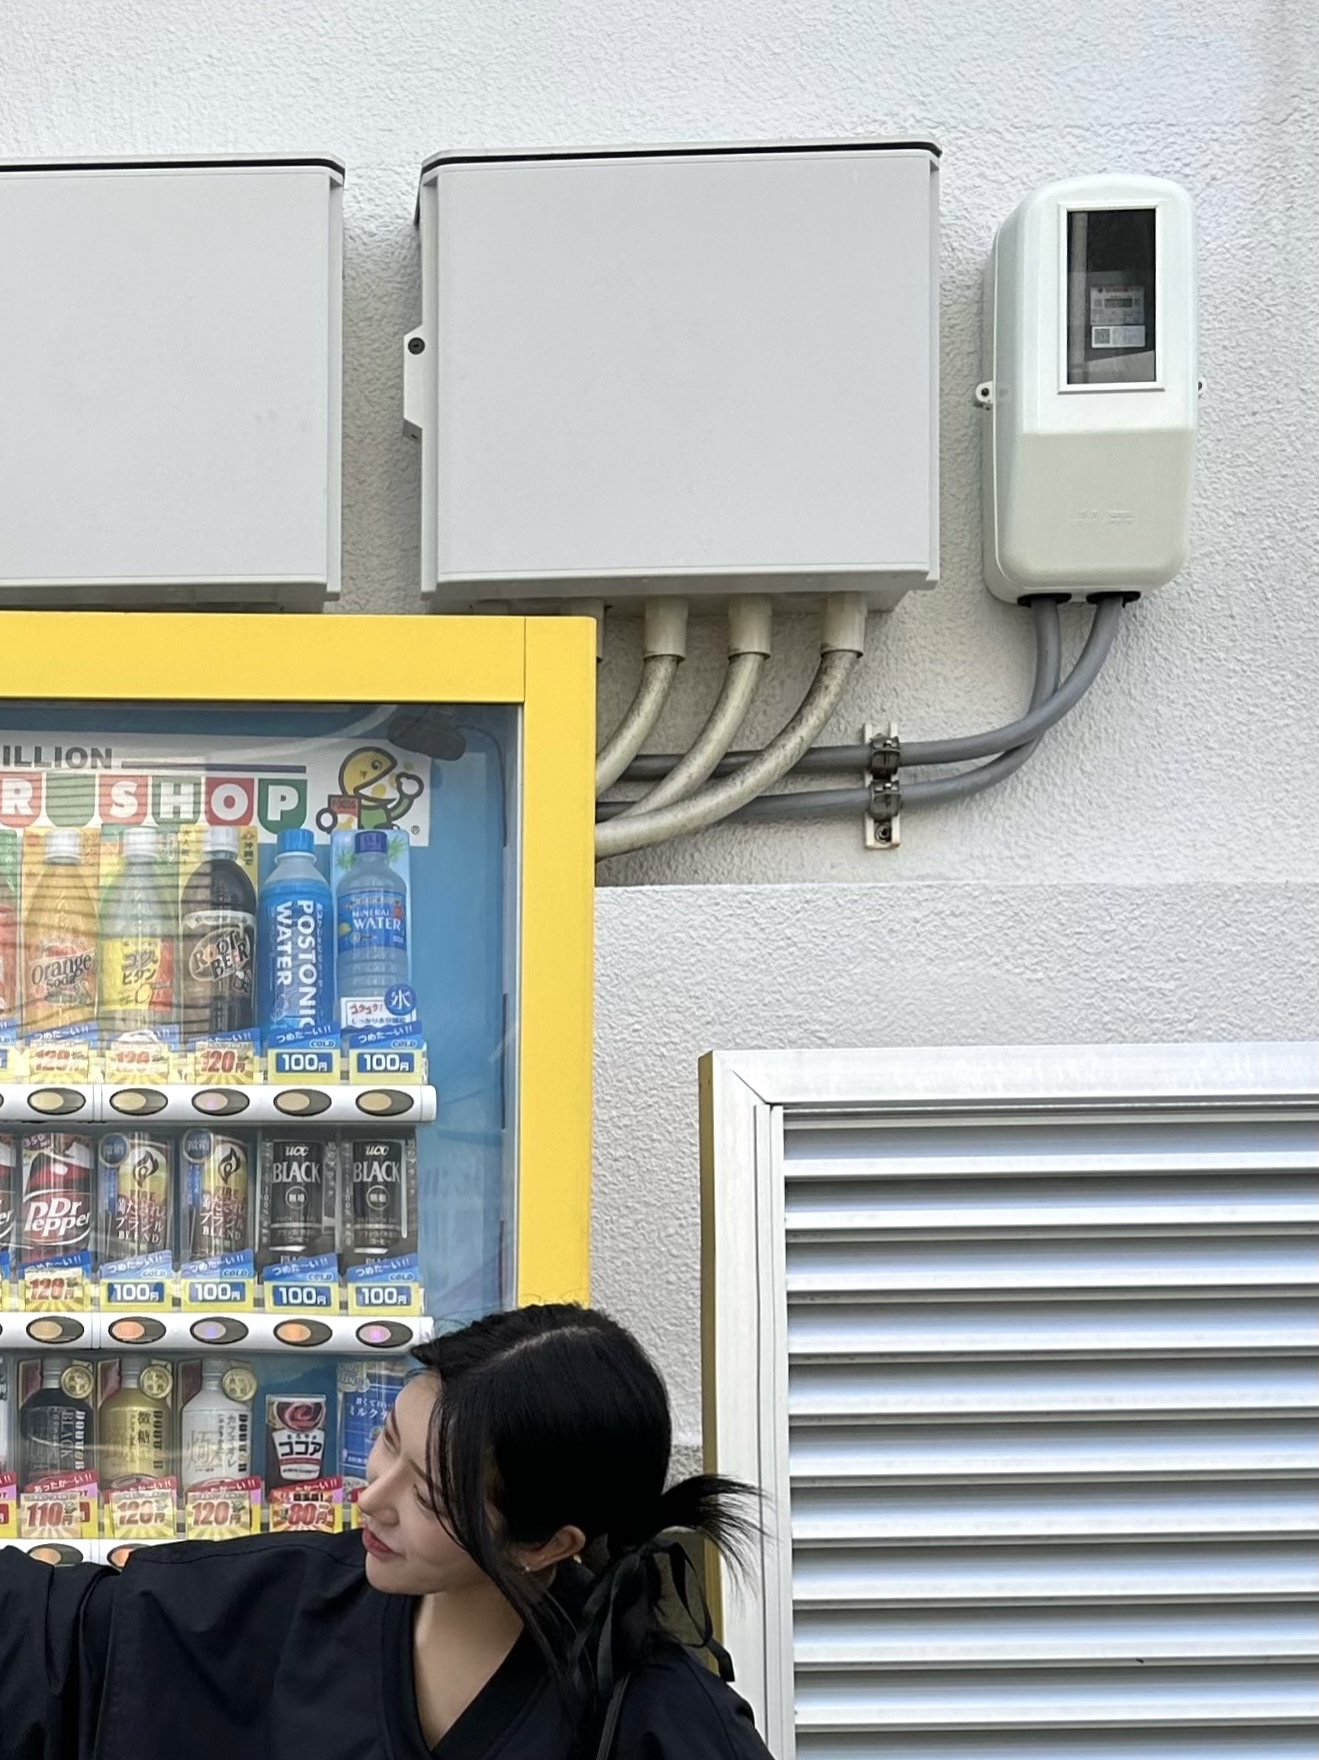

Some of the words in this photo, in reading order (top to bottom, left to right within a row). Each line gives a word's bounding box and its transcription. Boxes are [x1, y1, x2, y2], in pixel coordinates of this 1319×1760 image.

[108, 780, 300, 822] SHOP
[353, 917, 403, 931] WATER
[276, 901, 293, 986] WATER
[30, 953, 93, 987] Orange
[211, 941, 251, 979] BEER
[46, 973, 77, 989] soda
[282, 1053, 328, 1073] 100円
[364, 1053, 409, 1073] 100円
[272, 1161, 321, 1183] BLACK
[353, 1161, 400, 1183] BLACK
[48, 1197, 82, 1218] Dr
[24, 1201, 91, 1238] Pepper
[113, 1283, 160, 1302] 100円
[195, 1283, 241, 1301] 100円
[279, 1287, 326, 1305] 100円
[361, 1287, 408, 1305] 100円
[278, 1440, 322, 1457] ココア
[191, 1500, 242, 1526] 120円
